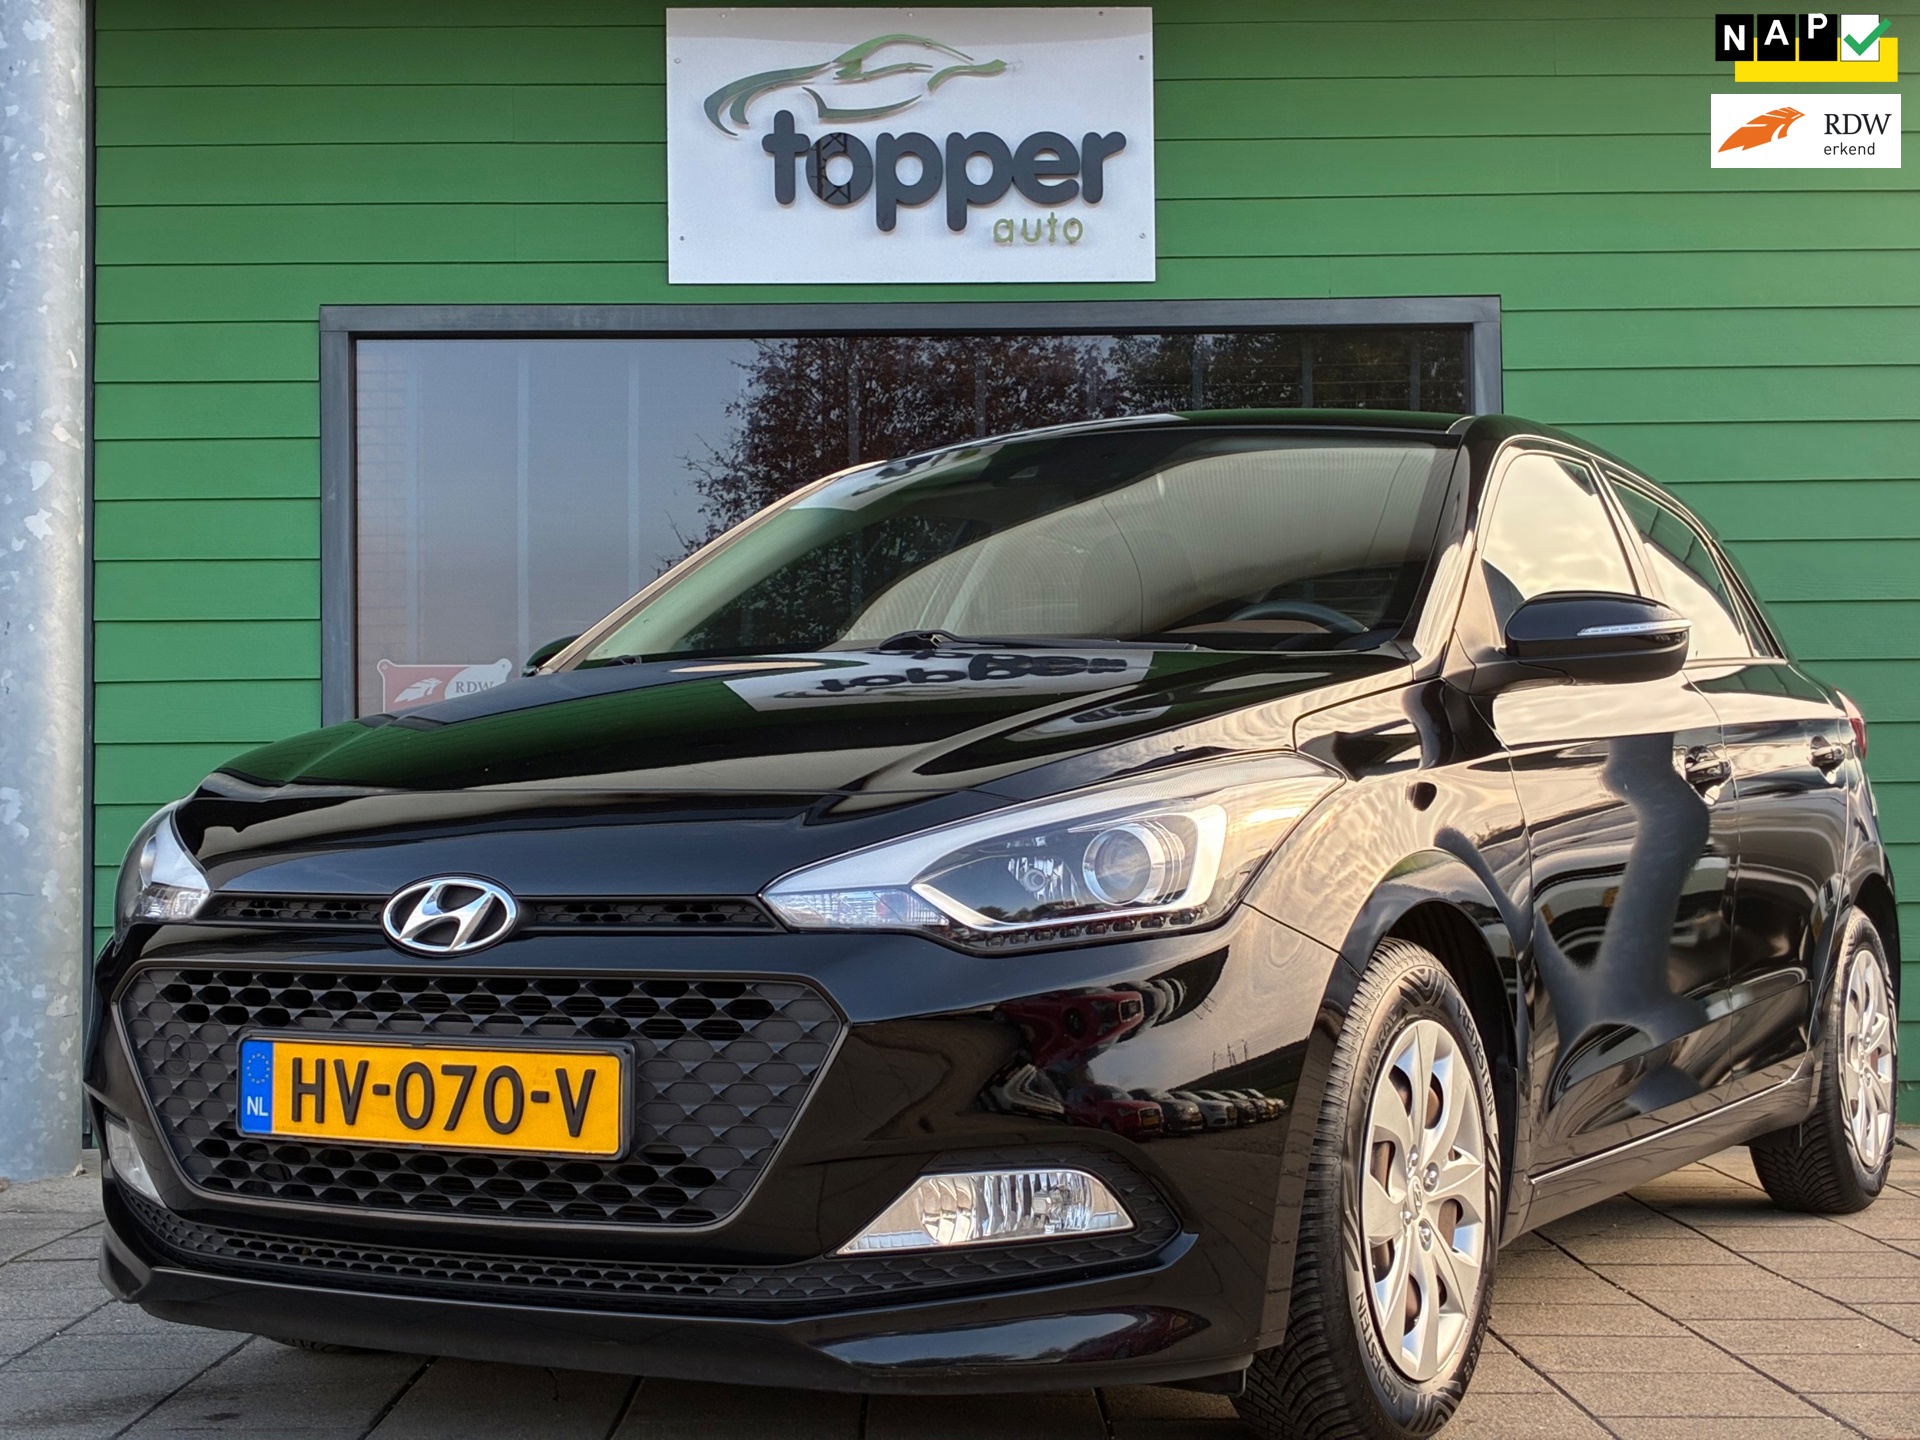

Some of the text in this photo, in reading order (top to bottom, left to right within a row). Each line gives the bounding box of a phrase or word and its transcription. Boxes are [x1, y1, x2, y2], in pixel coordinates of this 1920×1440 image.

[761, 109, 1127, 232] topper
[993, 212, 1083, 244] auto
[246, 1096, 269, 1117] NL
[291, 1057, 596, 1138] HV-070-V
